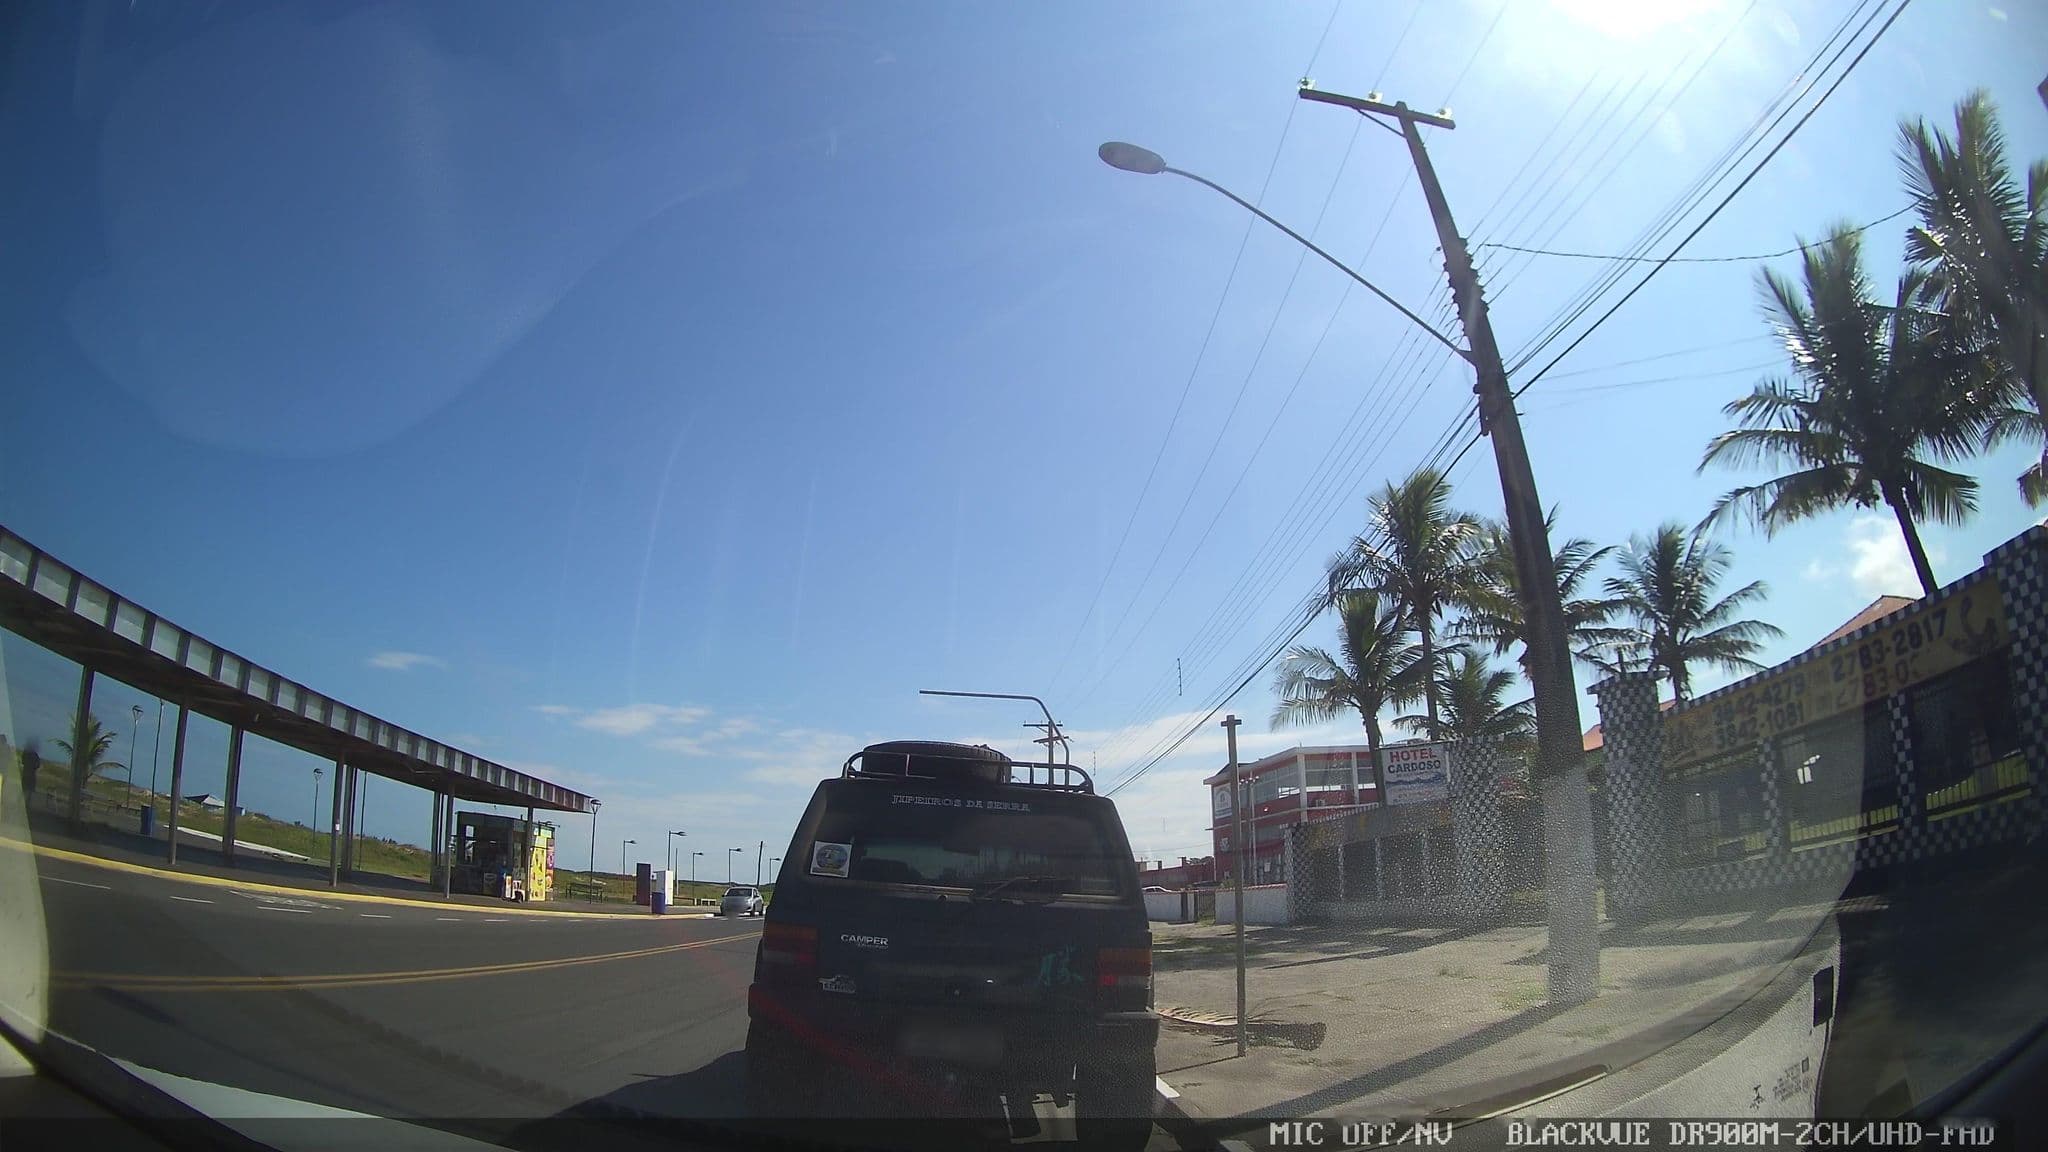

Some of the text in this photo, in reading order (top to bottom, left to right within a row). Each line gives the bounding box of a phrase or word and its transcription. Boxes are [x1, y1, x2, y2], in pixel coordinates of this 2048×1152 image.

[1389, 748, 1437, 763] HOTEL
[1388, 760, 1441, 774] CARDOSO
[891, 794, 1031, 812] JIPEIROS DA SERRA
[840, 934, 889, 946] CAMPER
